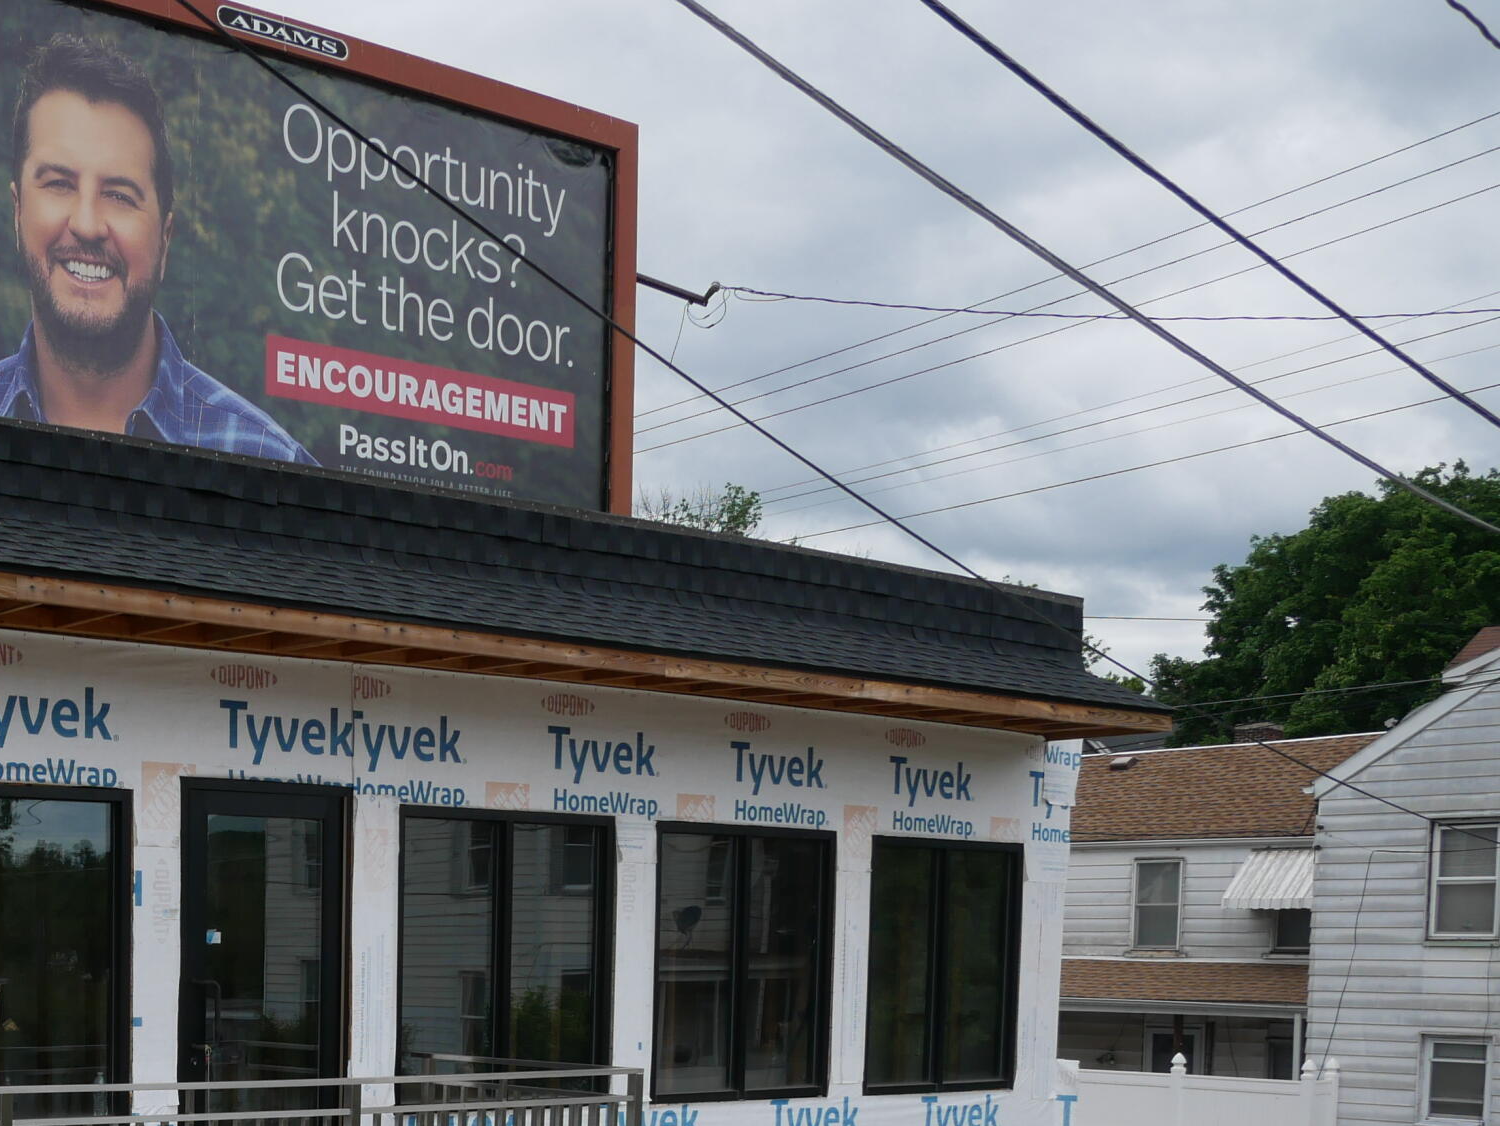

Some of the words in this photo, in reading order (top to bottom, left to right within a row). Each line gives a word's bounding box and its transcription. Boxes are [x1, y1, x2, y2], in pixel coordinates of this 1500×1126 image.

[230, 15, 338, 54] ADAMS
[283, 103, 565, 236] Opportunity
[333, 192, 526, 288] knocks?
[276, 252, 367, 329] Get
[380, 276, 455, 342] the
[467, 296, 574, 368] door.
[276, 350, 567, 434] ENCOURAGEMENT
[219, 664, 270, 689] DUPONT
[220, 699, 352, 765] Tyvek
[354, 711, 461, 772] yvek
[548, 725, 655, 784] Tyvek
[730, 741, 824, 793] Tyvek
[890, 756, 971, 807] Tyvek
[554, 788, 658, 820] HomeWrap
[735, 799, 826, 830] HomeWrap
[893, 811, 973, 836] HomeWrap
